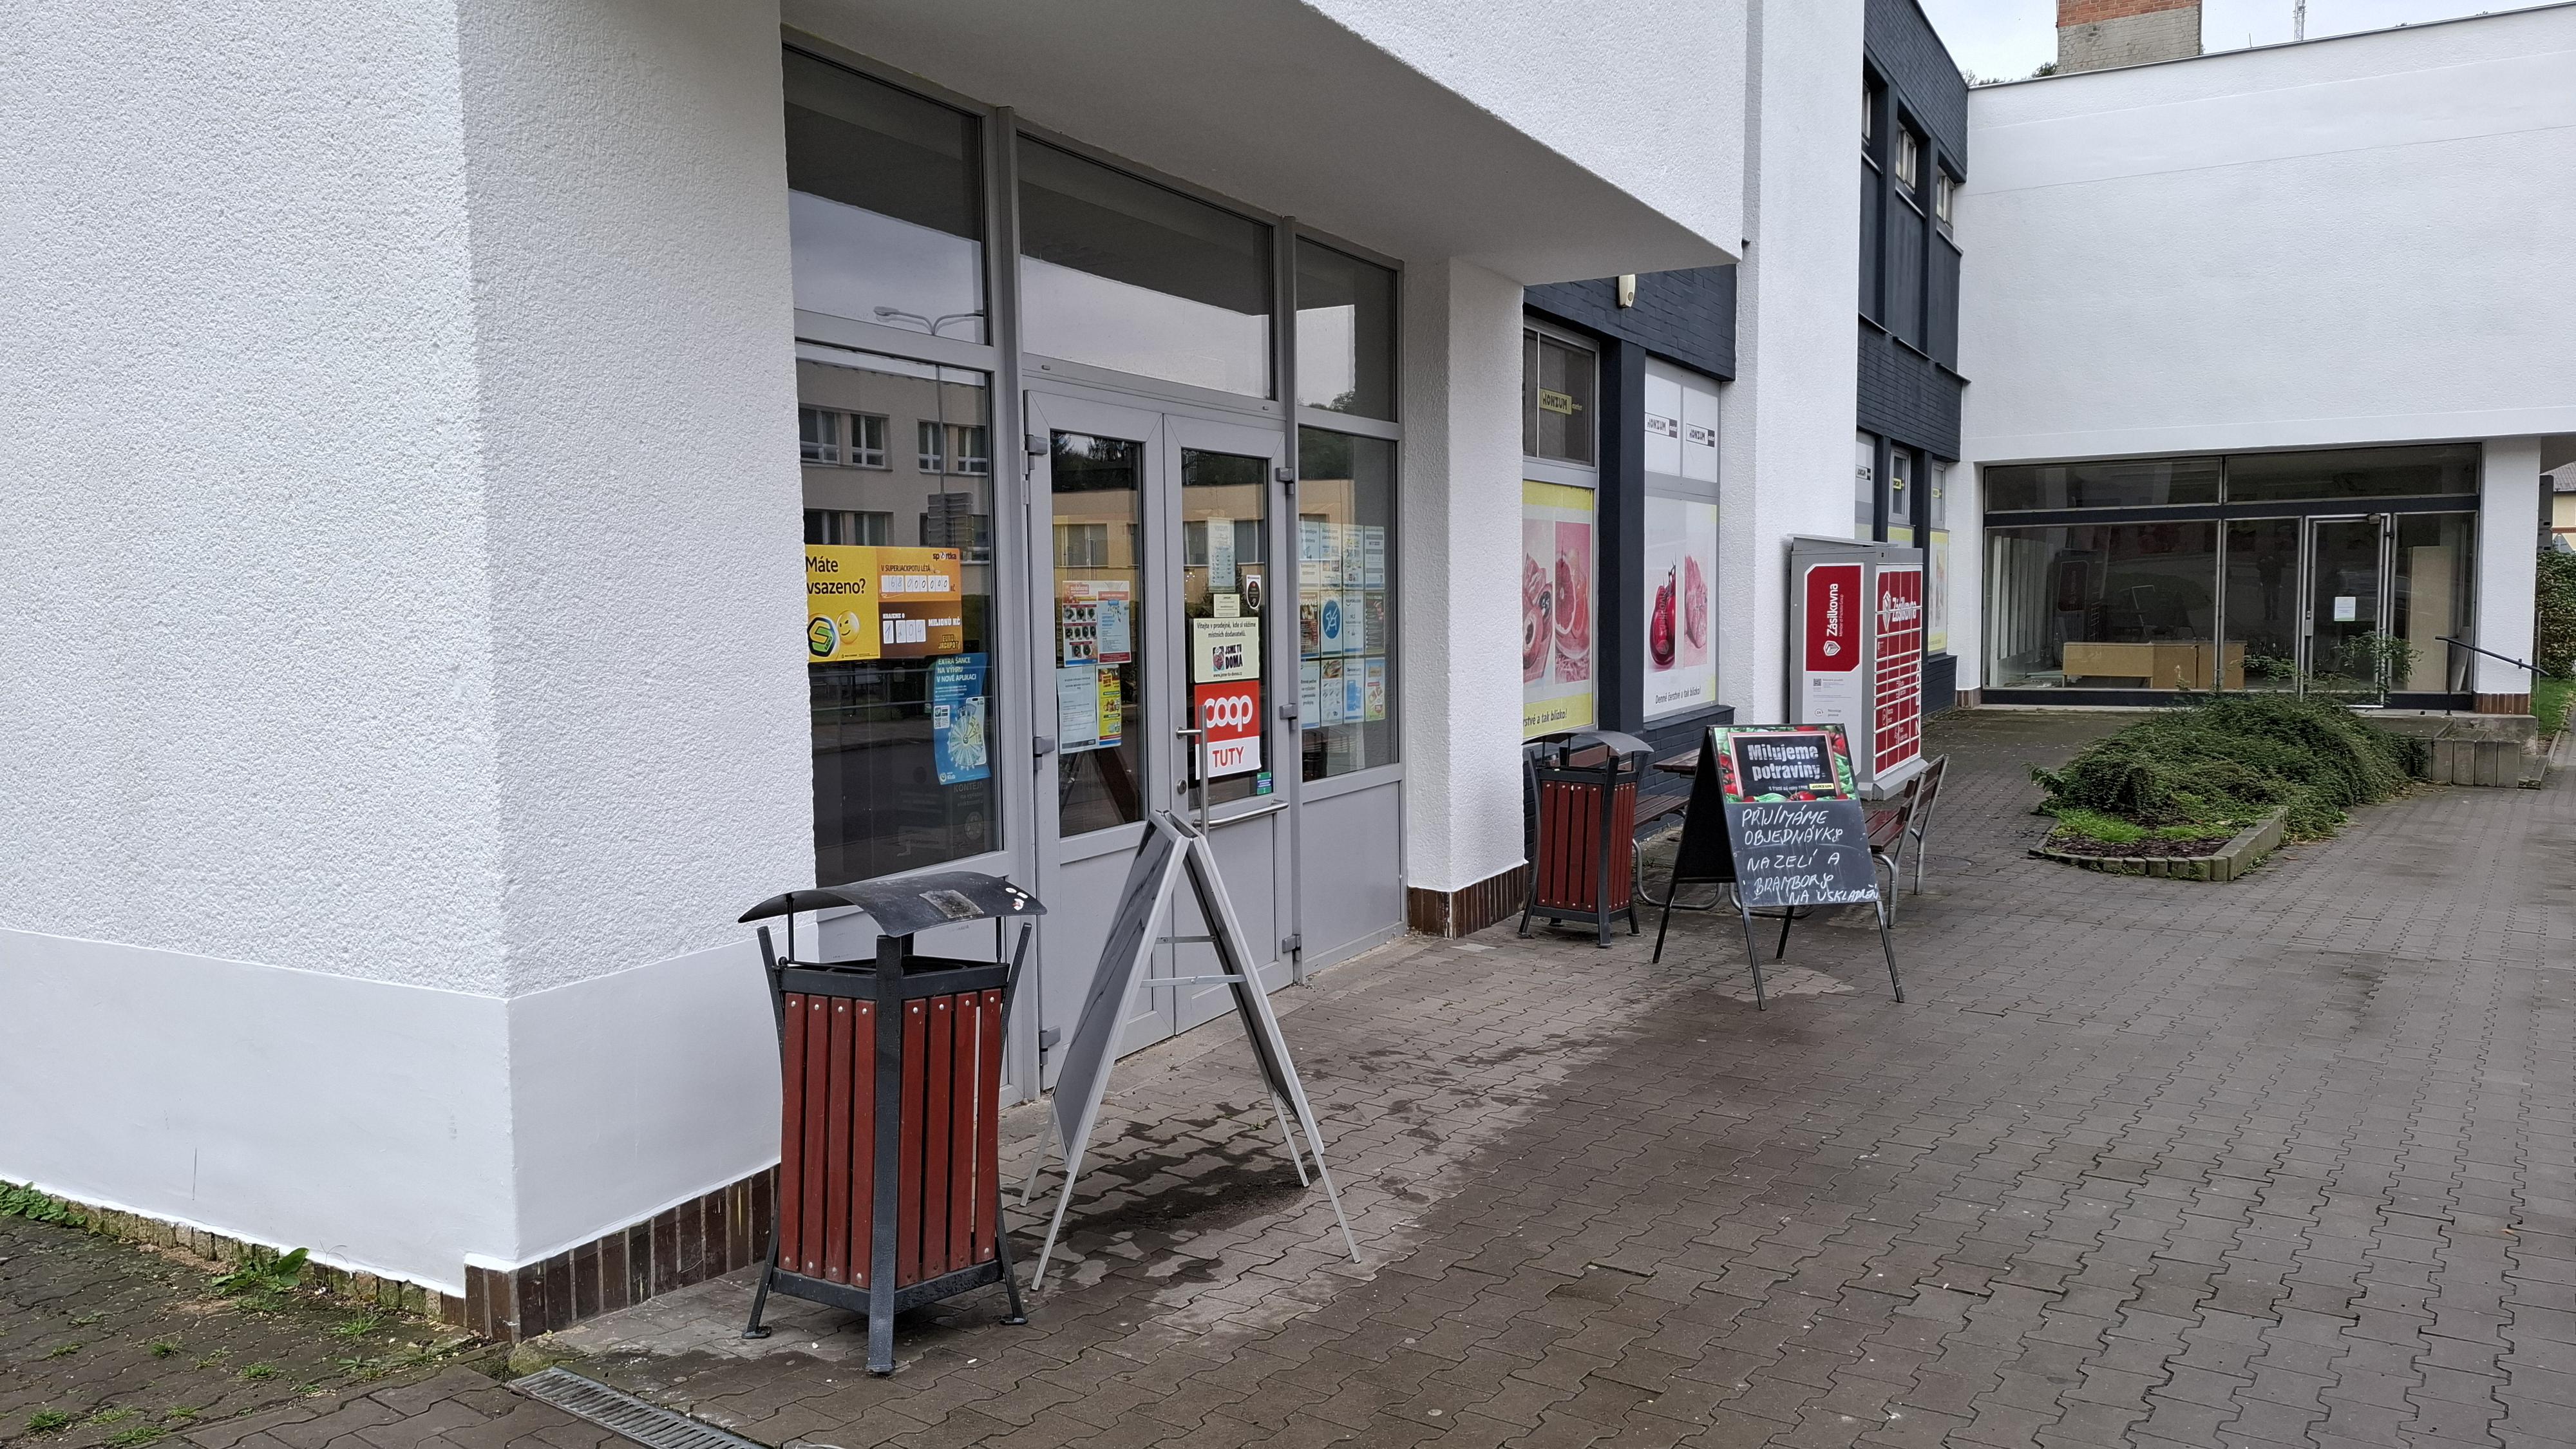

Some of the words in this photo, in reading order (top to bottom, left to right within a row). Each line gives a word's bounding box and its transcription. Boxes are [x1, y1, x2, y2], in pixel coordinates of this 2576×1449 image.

[1542, 391, 1567, 410] KONZUM
[806, 556, 838, 573] Máte
[933, 552, 957, 560] sportka
[806, 578, 866, 594] vsazeno?
[1826, 583, 1839, 637] Zásilkovna
[928, 616, 951, 626] MILIONŮ
[1226, 654, 1243, 670] DOMA
[1204, 695, 1253, 732] coop
[1551, 708, 1567, 721] blízko!
[1212, 746, 1244, 768] TUTY
[1747, 744, 1819, 761] Milujeme
[1745, 824, 1843, 846] OBJEDNÁVKY
[1747, 857, 1770, 873] NA
[1774, 848, 1818, 869] ZELÍ
[1828, 852, 1840, 866] A
[1754, 872, 1834, 897] BRAMBORY
[1789, 889, 1810, 905] NA
